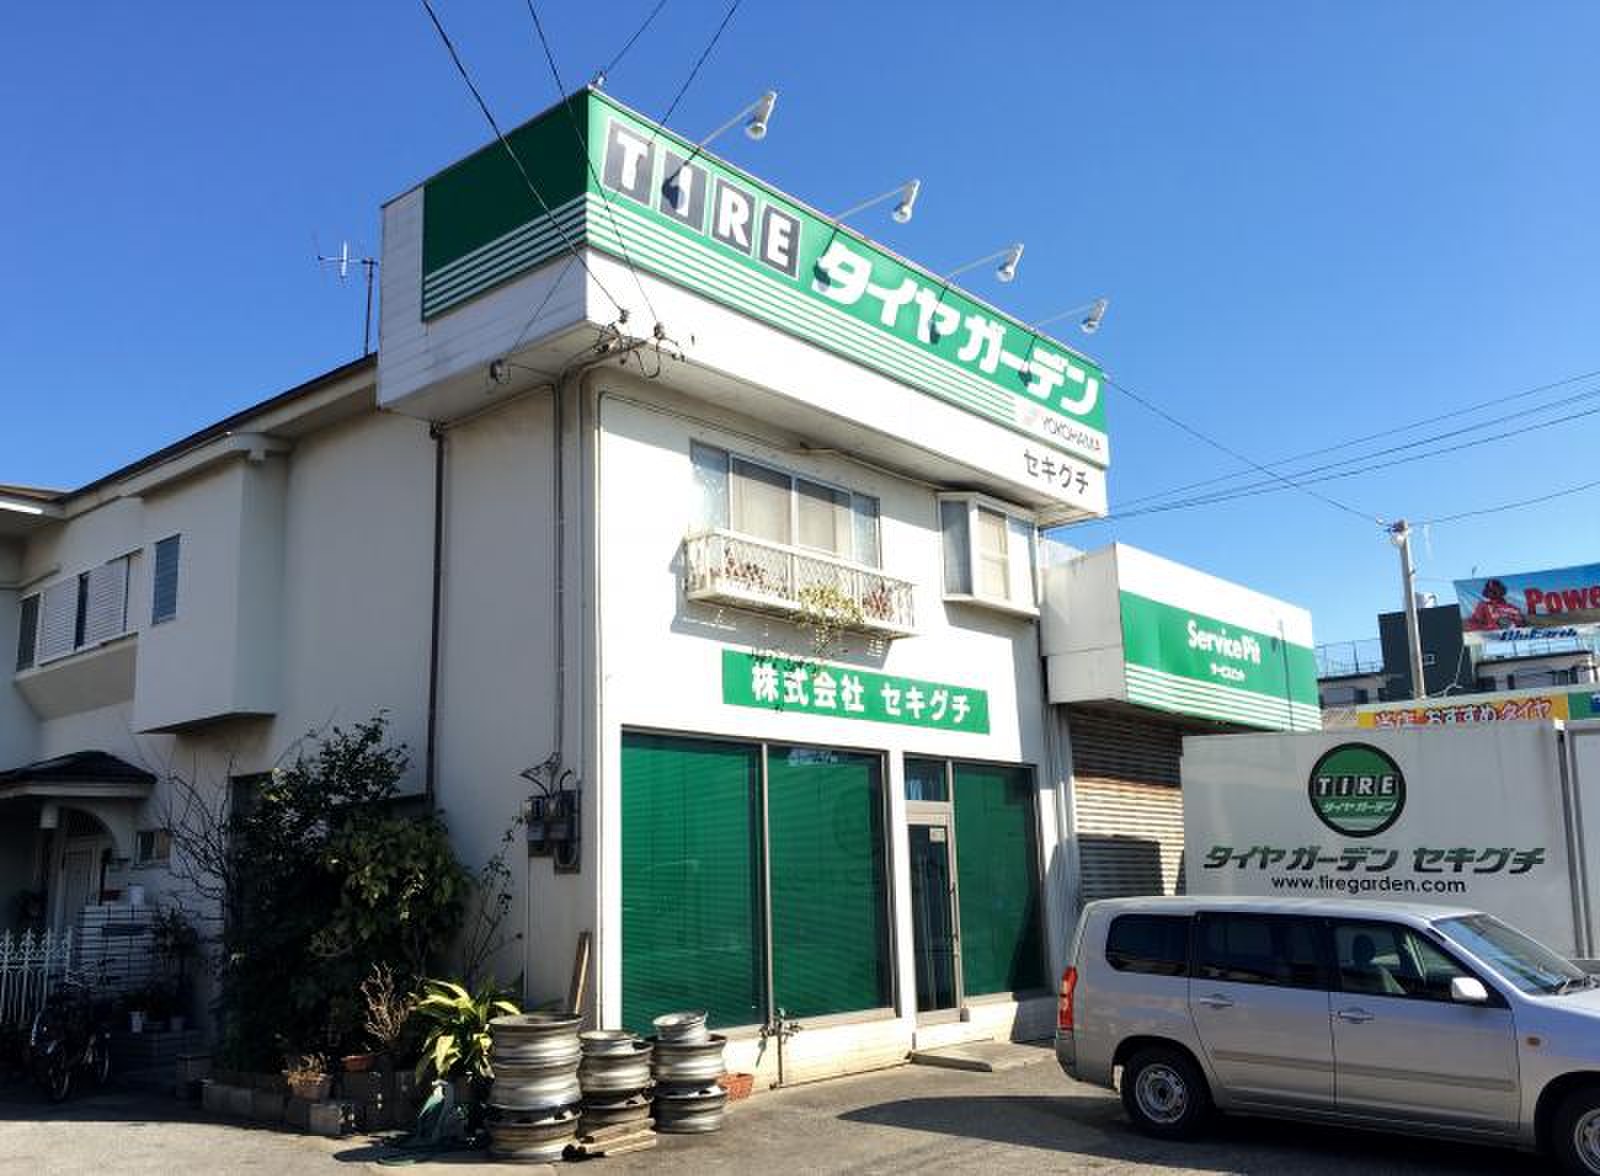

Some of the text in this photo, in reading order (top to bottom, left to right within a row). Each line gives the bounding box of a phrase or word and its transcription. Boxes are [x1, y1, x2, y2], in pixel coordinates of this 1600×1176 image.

[616, 127, 793, 268] TIRE
[811, 239, 1100, 416] タイヤガーデン
[1023, 448, 1089, 495] セキグチ
[752, 661, 971, 724] 株式会社 セキグチ
[1319, 776, 1393, 795] TIRE
[1203, 846, 1546, 875] タイヤガーデン セキグチ
[1271, 875, 1467, 894] www.tiregarden.com
